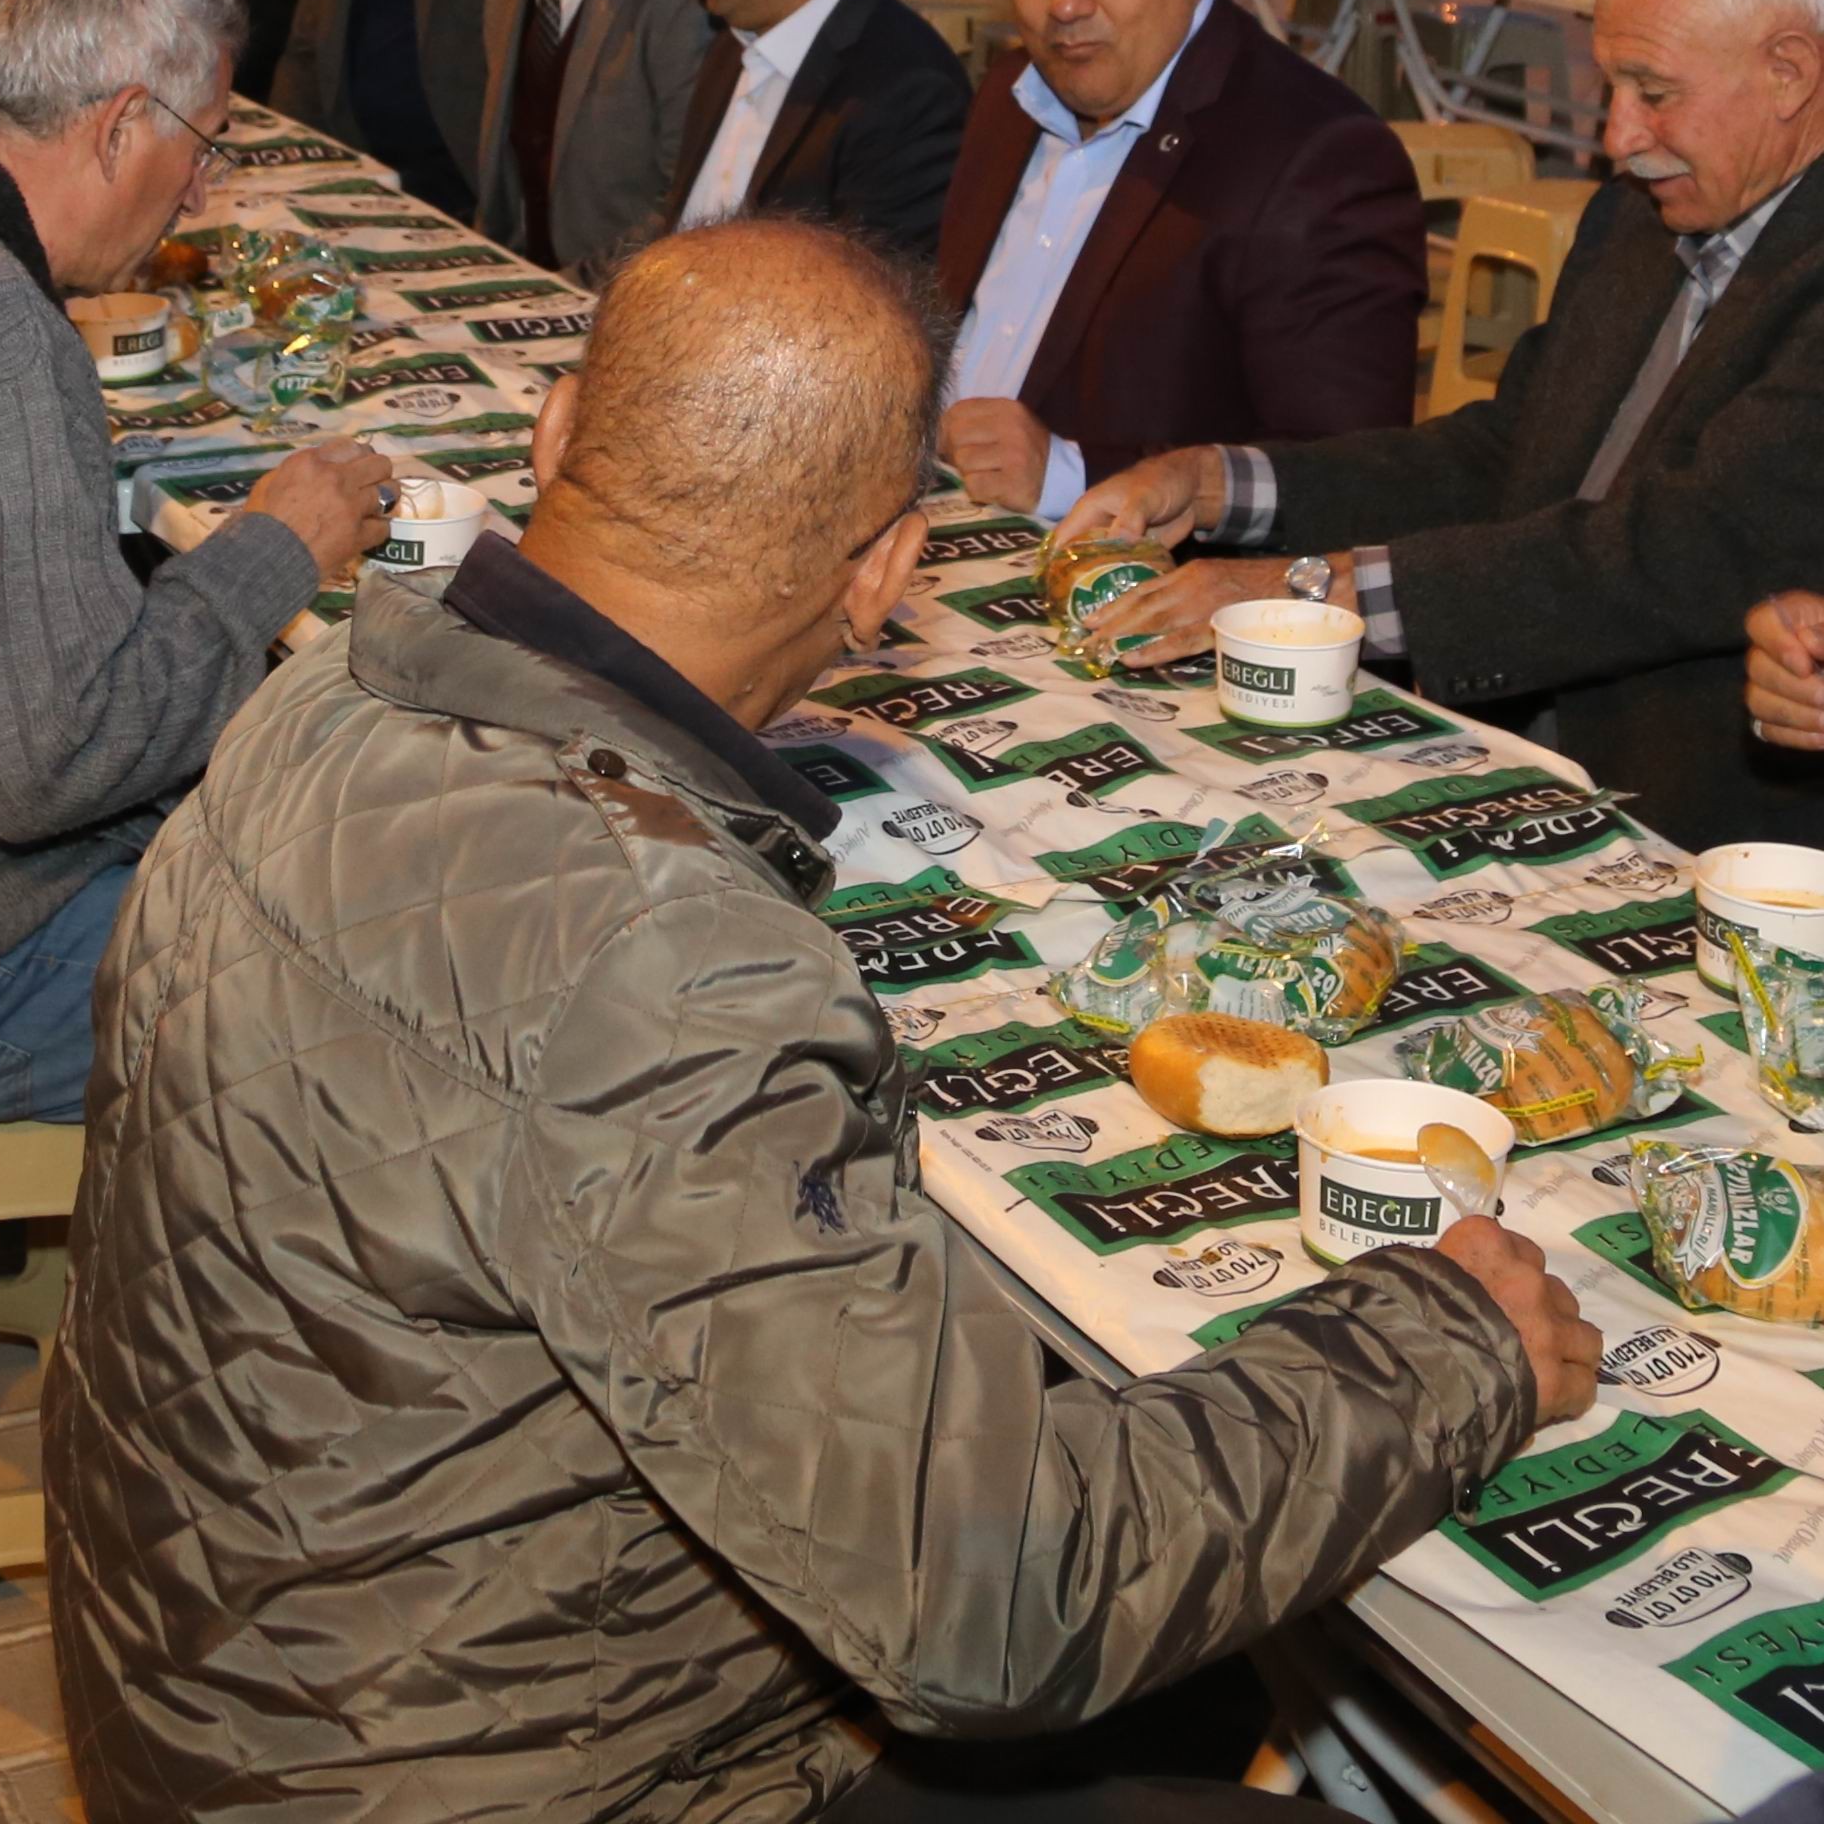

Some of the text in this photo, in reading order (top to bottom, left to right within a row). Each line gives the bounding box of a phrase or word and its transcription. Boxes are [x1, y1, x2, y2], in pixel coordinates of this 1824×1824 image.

[1325, 1186, 1432, 1230] EREĞLİ
[1673, 1549, 1705, 1574] ALO
[1644, 1565, 1736, 1621] 710 07 07
